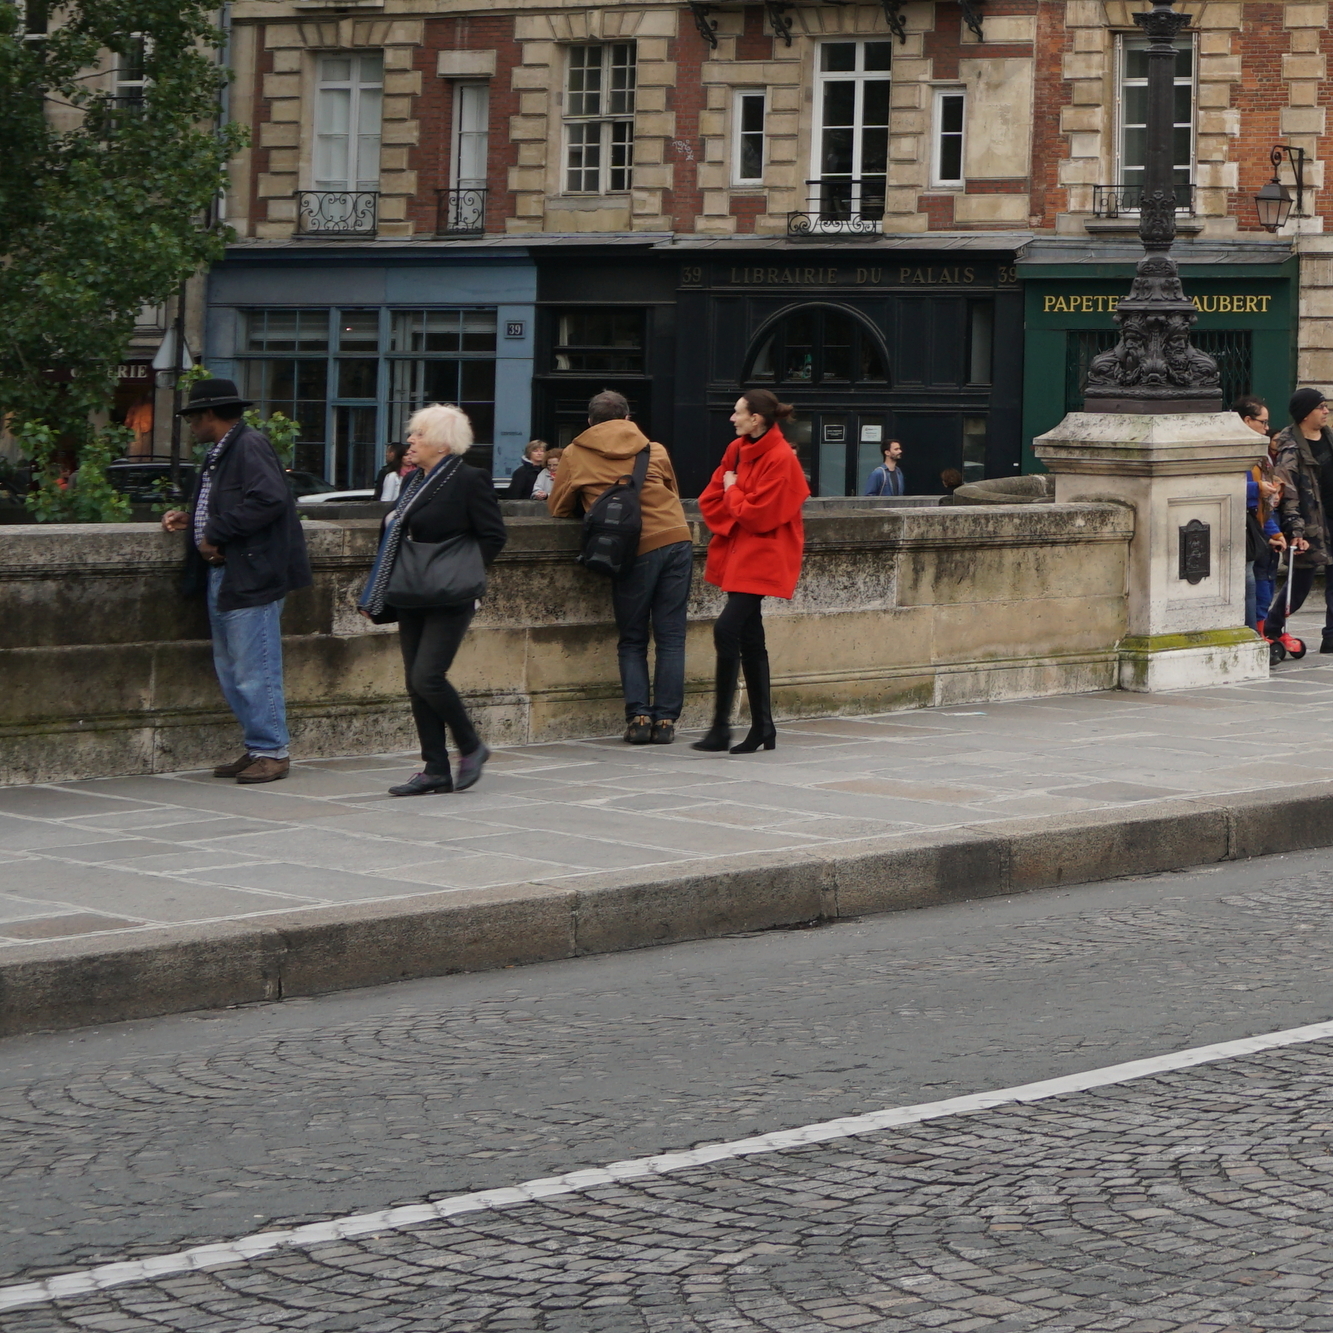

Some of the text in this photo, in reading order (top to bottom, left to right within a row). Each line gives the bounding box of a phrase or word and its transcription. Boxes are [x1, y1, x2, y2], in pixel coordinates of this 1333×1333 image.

[682, 266, 1017, 284] 39 LIBRAIRIE DU PALAIS 39
[1043, 295, 1271, 313] PAPETE AUBERT
[508, 324, 521, 335] 39
